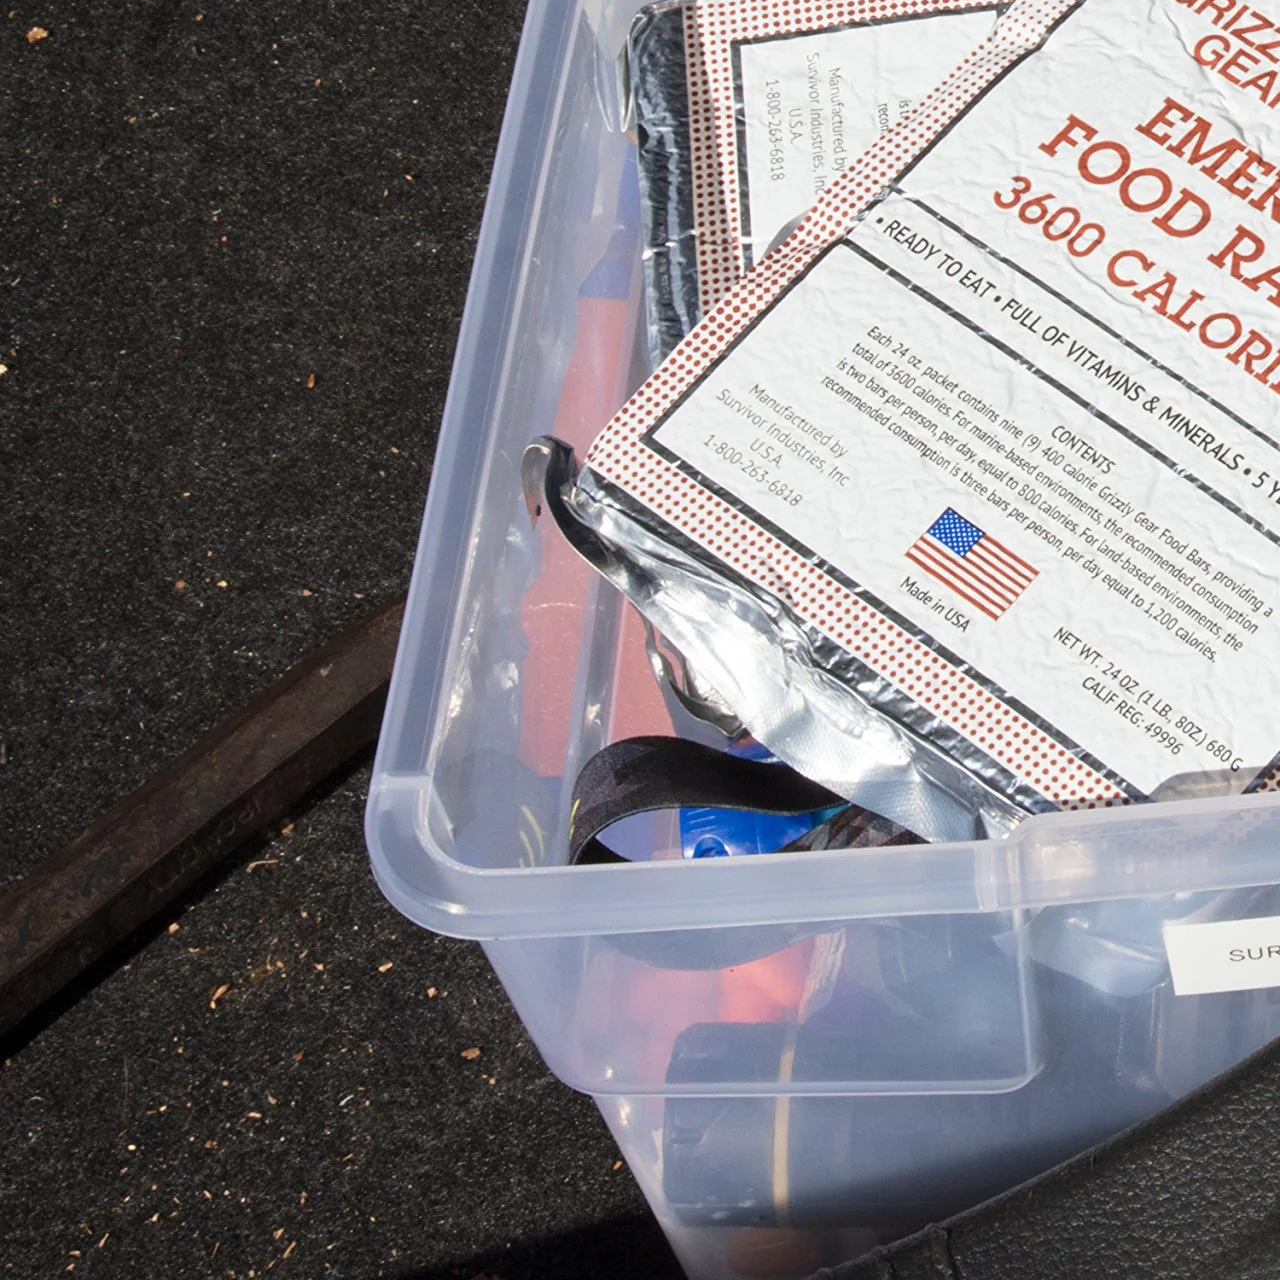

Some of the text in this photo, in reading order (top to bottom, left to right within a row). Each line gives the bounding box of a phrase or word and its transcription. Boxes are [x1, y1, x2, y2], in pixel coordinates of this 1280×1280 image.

[806, 52, 820, 104] Survivor
[829, 67, 848, 173] Manufactured by
[766, 79, 785, 182] 1-800-263-6818
[809, 108, 827, 172] Industries,
[1037, 113, 1212, 238] FOOD
[992, 174, 1106, 258] 3600
[882, 219, 942, 260] READY
[936, 252, 963, 277] TO
[957, 268, 997, 298] EAT
[1000, 297, 1042, 334] FULL
[1040, 324, 1070, 346] OF
[1065, 339, 1146, 402] VITAMINS
[1141, 395, 1160, 414] &
[1157, 405, 1245, 471] MINERALS
[1250, 470, 1270, 488] 5
[702, 433, 803, 507] 1-800-263-6818
[715, 387, 850, 487] Survivor Industries, Inc
[747, 382, 848, 459] Manufactured by
[749, 437, 783, 469] U.S.A.
[1050, 424, 1116, 474] CONTENTS
[820, 375, 1216, 663] recommended consumption is three bars per person, per day equal to 1,200 calories.
[835, 356, 1243, 652] is two bars per person, per day, equal to 800 calories. For land-based environments, the
[851, 341, 1259, 634] total of 3600 calories. For marine-based environments, the recommended consumption
[866, 324, 1273, 618] Each 24 oz. packet contains nine (9) 400 calorie Grizzly Gear Food Bars, providing a
[899, 575, 971, 632] Made in USA
[1052, 625, 1082, 649] NET
[1078, 642, 1103, 668] WT.
[1100, 661, 1122, 680] 24
[1135, 689, 1154, 705] (1
[1151, 698, 1173, 724] LB.,
[1205, 739, 1232, 762] 680
[1223, 757, 1243, 776] G
[1081, 675, 1184, 755] CALIF REG: 49996
